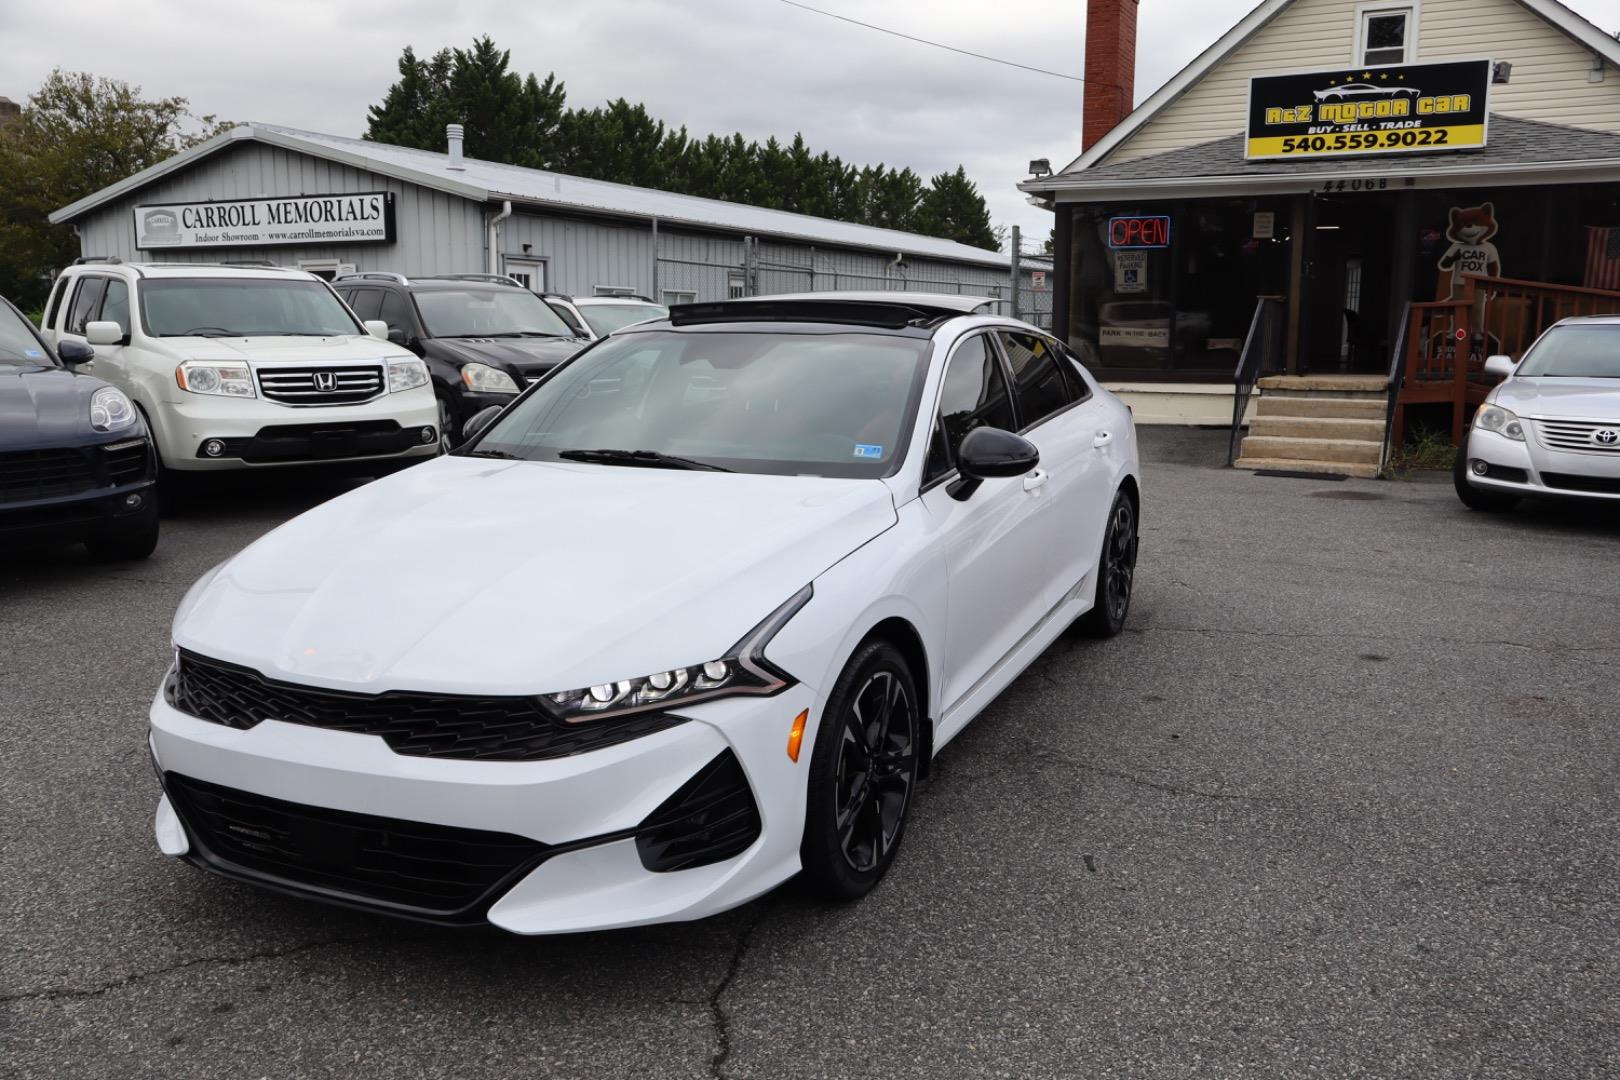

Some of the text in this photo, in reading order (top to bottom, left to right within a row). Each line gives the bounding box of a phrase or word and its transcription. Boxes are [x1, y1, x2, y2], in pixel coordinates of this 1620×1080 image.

[1318, 98, 1409, 124] MOTOR
[1308, 120, 1422, 134] BUY SELL TRADE
[1281, 129, 1449, 152] 540.559.9022
[182, 197, 380, 229] CARROLL MEMORIALS
[195, 226, 384, 242] Indoor Showroom www.carrollmemorialsva.com
[1112, 218, 1168, 245] OPEN
[1462, 250, 1486, 261] CAR
[1461, 261, 1483, 272] FOX
